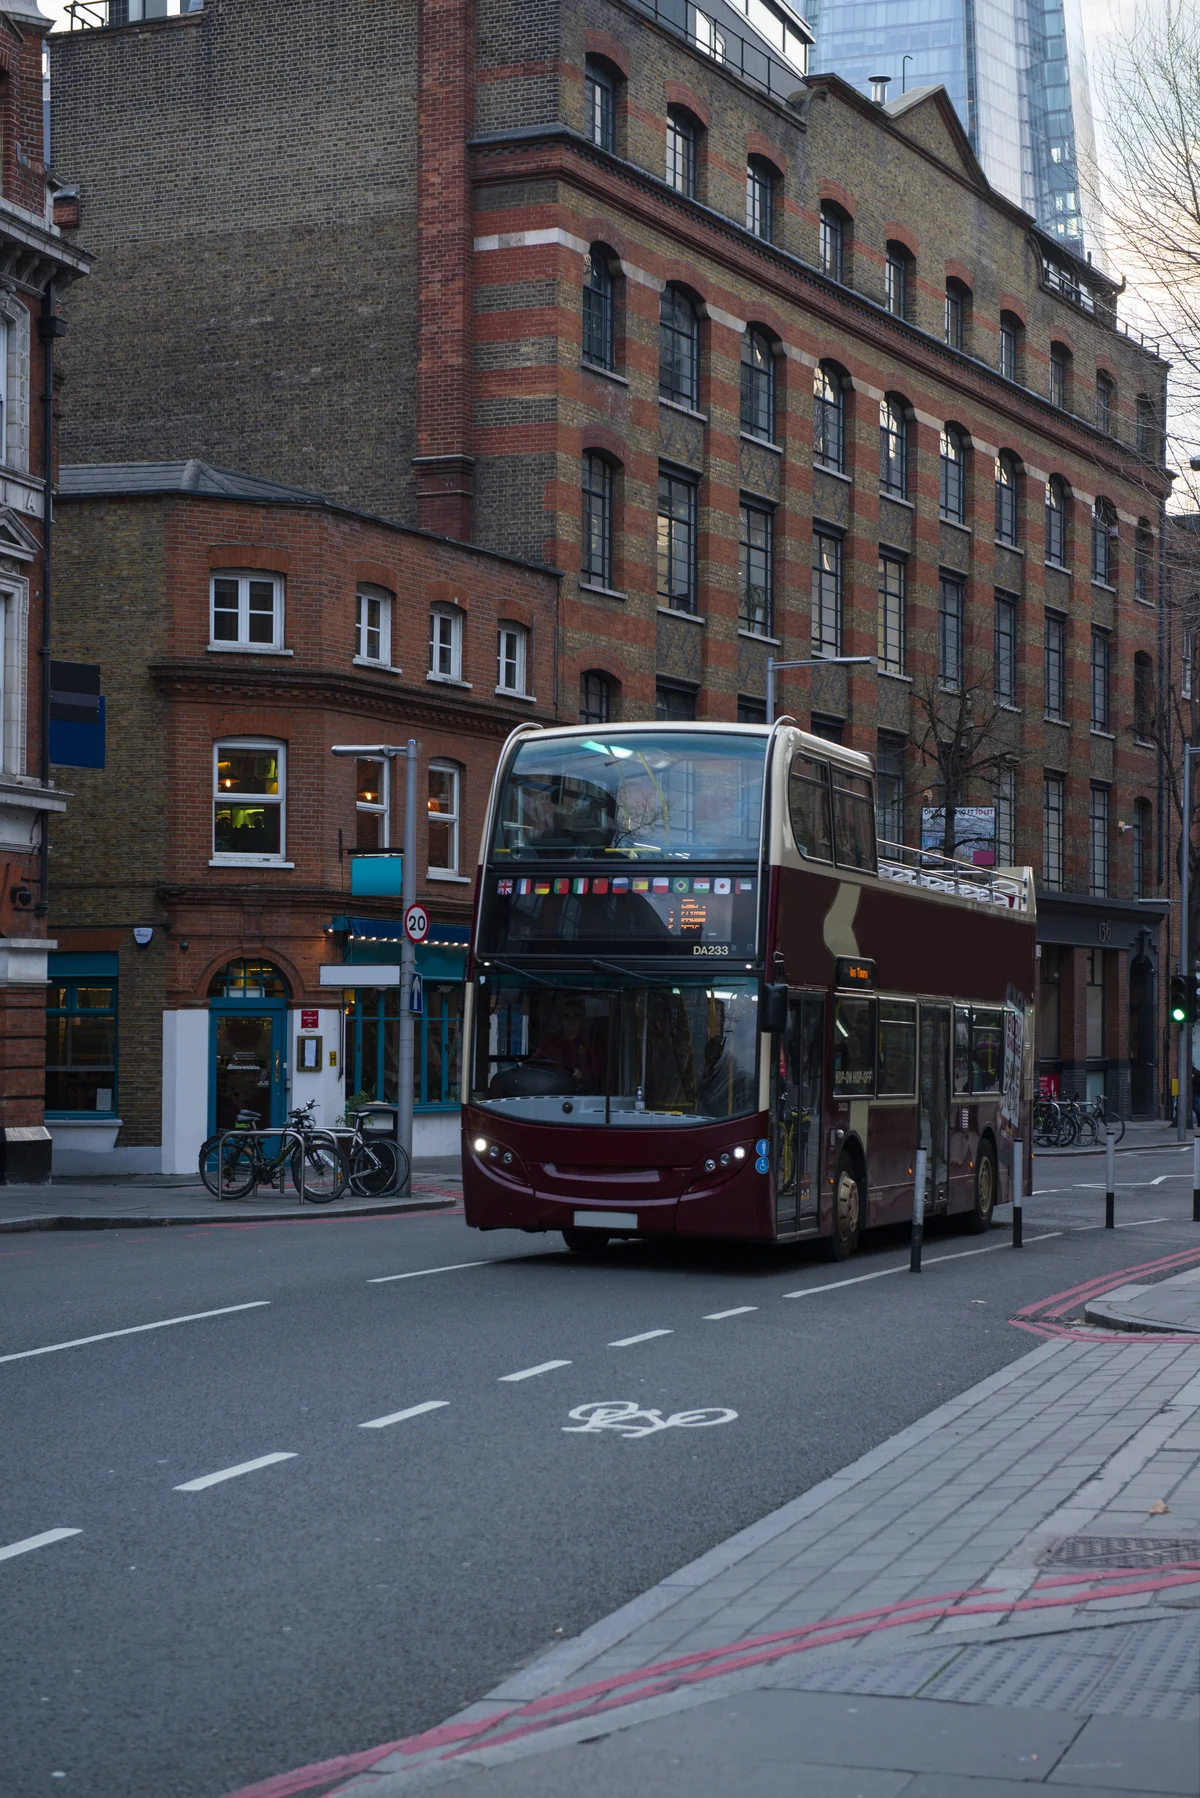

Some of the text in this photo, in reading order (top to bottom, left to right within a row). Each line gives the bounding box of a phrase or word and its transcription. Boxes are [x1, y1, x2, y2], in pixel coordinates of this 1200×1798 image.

[408, 915, 426, 931] 20
[1098, 919, 1112, 943] 136
[693, 945, 729, 955] DA233
[834, 1071, 873, 1084] HOP-ON HOP-OFF
